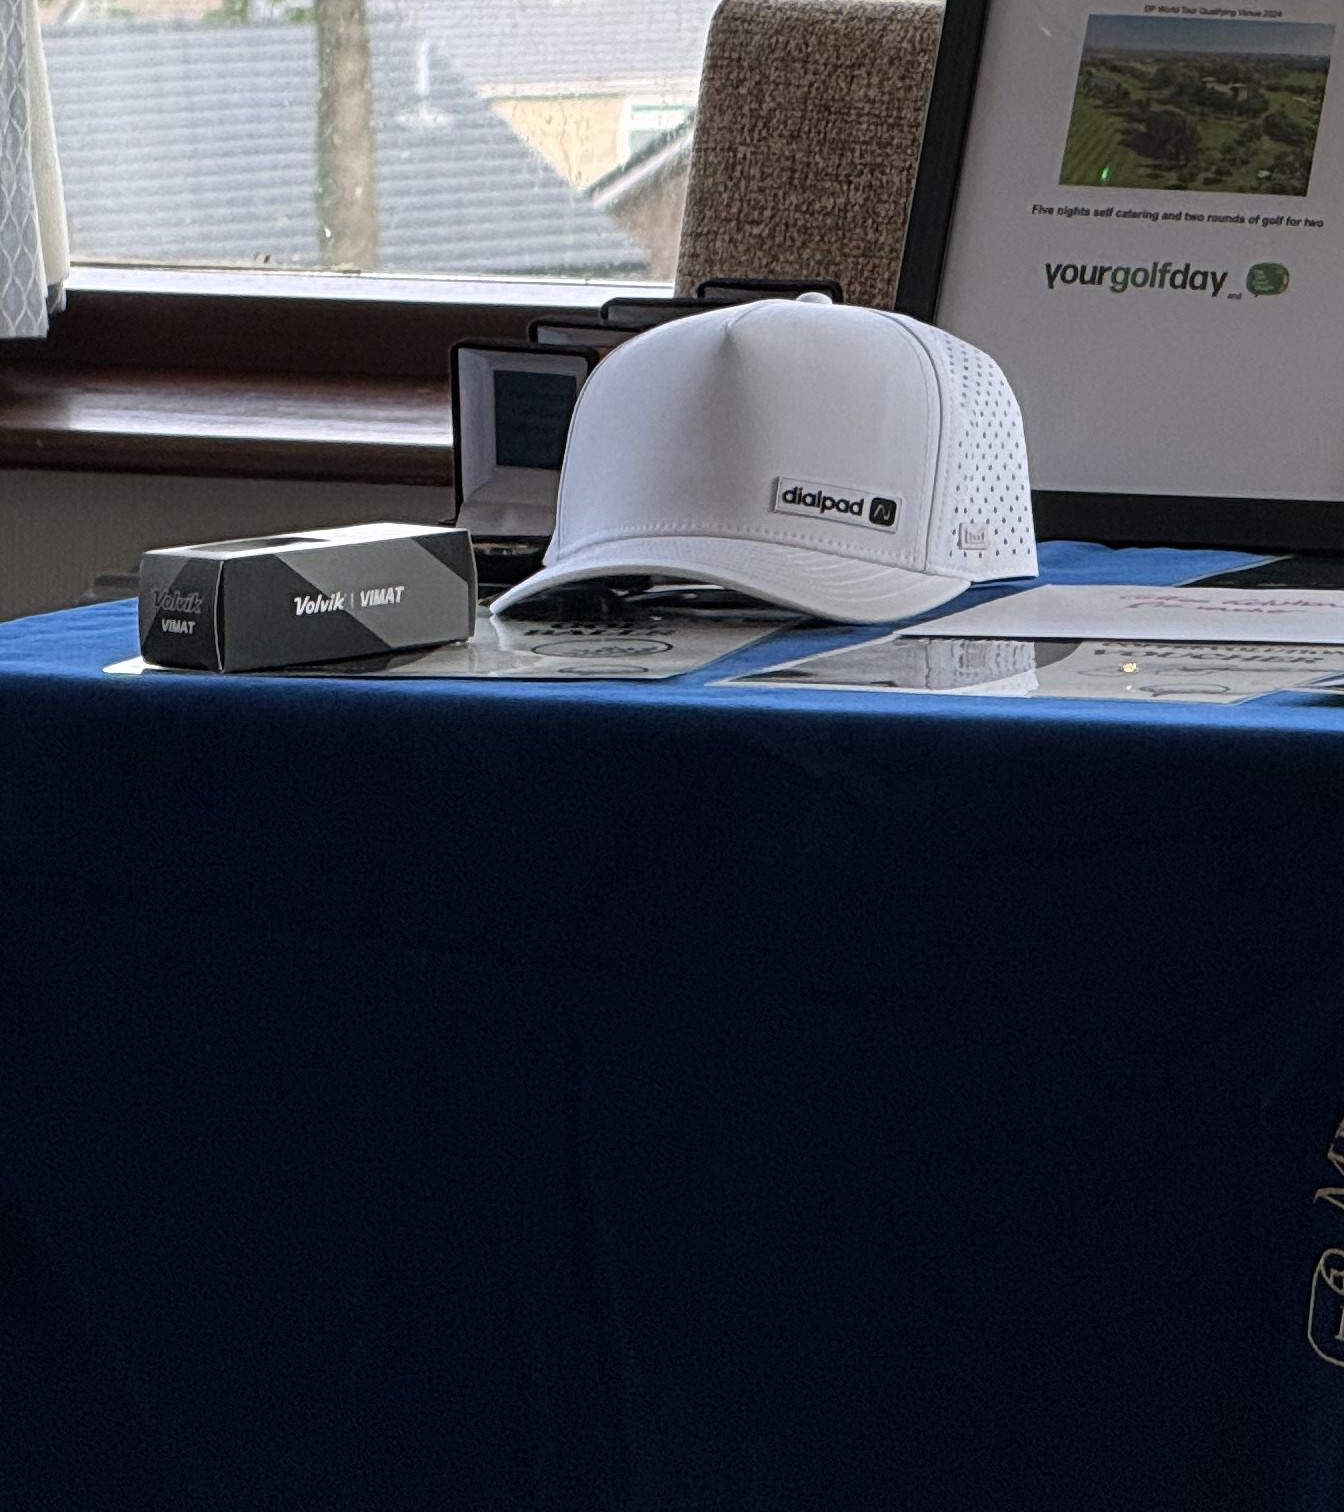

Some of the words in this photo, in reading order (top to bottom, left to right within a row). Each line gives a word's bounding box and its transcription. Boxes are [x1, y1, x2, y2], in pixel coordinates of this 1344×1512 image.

[1032, 204, 1053, 215] Five
[1057, 206, 1090, 219] nights
[1093, 207, 1113, 218] self
[1116, 208, 1159, 222] catering
[1162, 211, 1181, 221] and
[1184, 213, 1204, 222] two
[1207, 212, 1245, 224] rounds
[1248, 214, 1260, 225] of
[1262, 215, 1284, 228] golf
[1286, 216, 1302, 227] for
[1304, 218, 1324, 228] two
[1045, 262, 1228, 297] yourgolfday
[782, 487, 864, 516] dialpad
[152, 590, 202, 613] Volvik
[294, 591, 345, 616] Volvik
[360, 586, 404, 607] VIMAT
[161, 619, 195, 634] VIMAT
